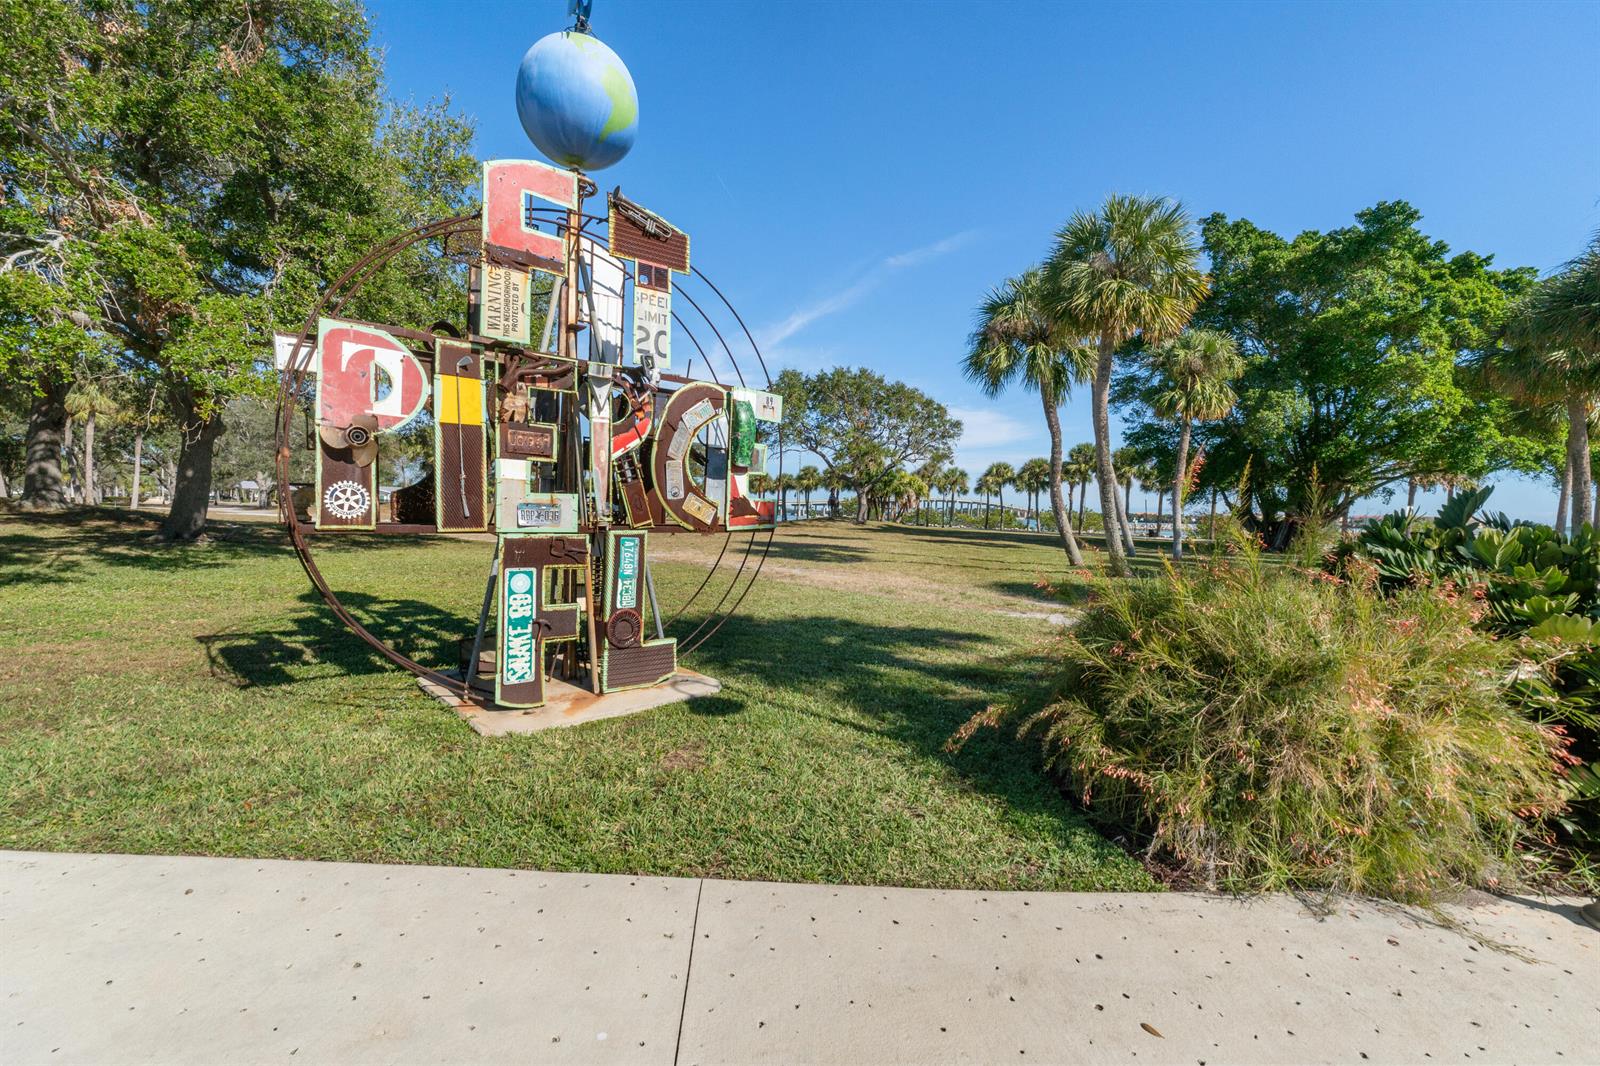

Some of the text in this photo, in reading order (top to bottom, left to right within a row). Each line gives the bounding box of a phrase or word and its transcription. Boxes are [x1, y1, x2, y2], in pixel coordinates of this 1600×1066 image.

[487, 272, 502, 330] WARNING
[503, 271, 512, 337] THIS NEIGHBORHOOD
[511, 282, 519, 332] PROTECTED BY
[507, 623, 533, 683] SNAKE
